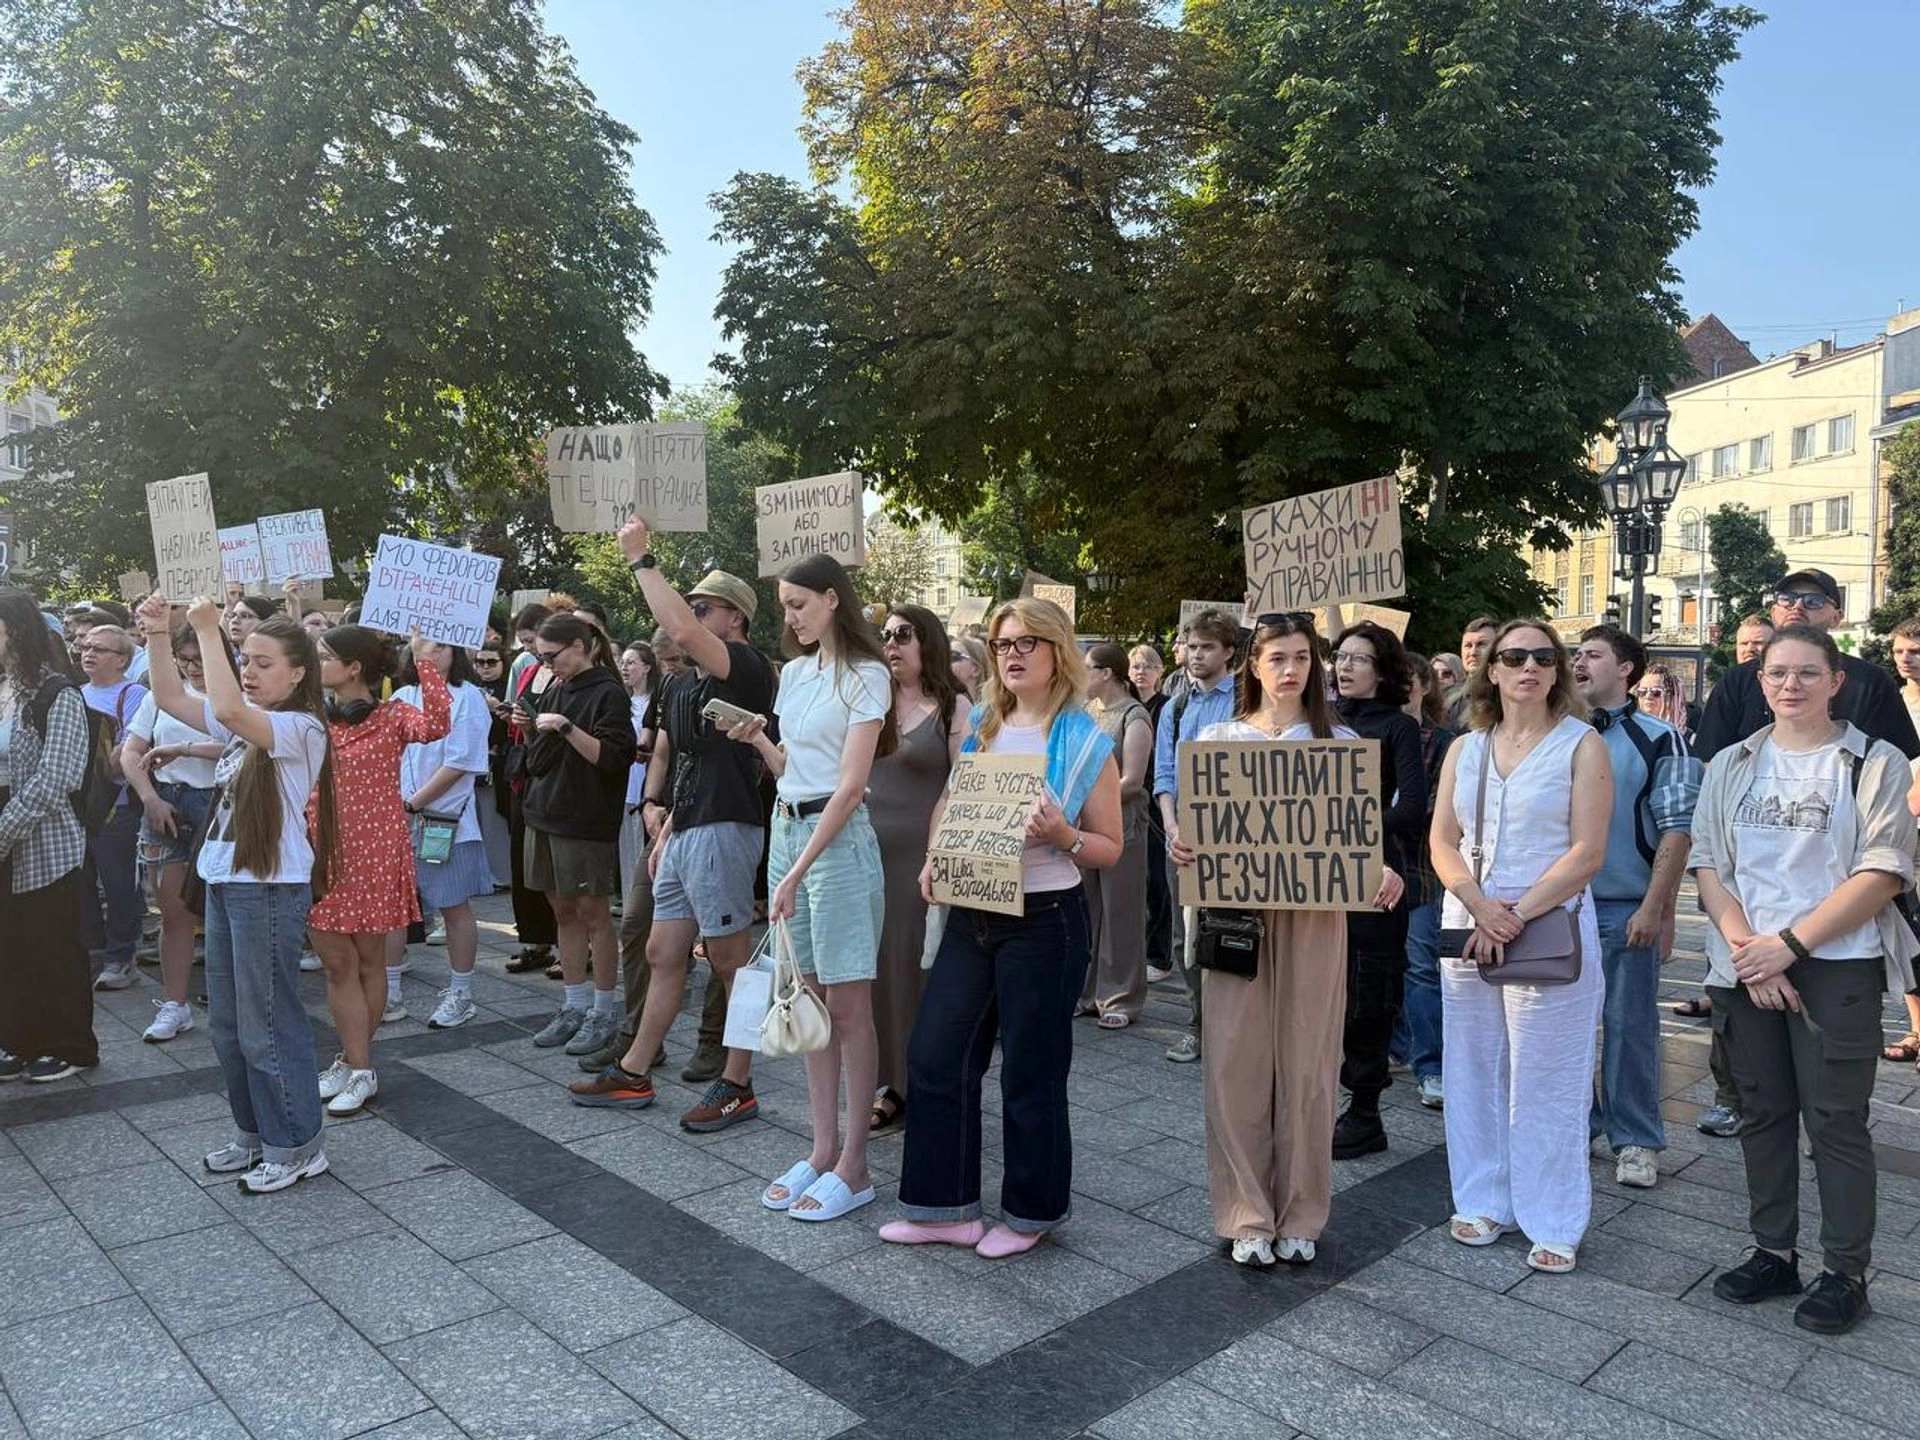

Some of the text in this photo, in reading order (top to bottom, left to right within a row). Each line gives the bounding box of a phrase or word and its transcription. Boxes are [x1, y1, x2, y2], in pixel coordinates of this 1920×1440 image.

[558, 433, 623, 463] НАЩО
[793, 511, 820, 532] АБО
[1246, 478, 1391, 542] СКАЖИ НІ
[378, 540, 498, 583] МО ФЕДОРОВ
[1253, 517, 1379, 573] РУЧНОМУ
[1247, 548, 1404, 613] УПРАВЛІННЮ
[365, 607, 401, 629] ДЛЯ
[1193, 746, 1369, 797] НЕ ЧІПАЙТЕ
[1325, 796, 1379, 847] ДАЄ
[1196, 852, 1371, 904] РЕЗУЛЬТАТ
